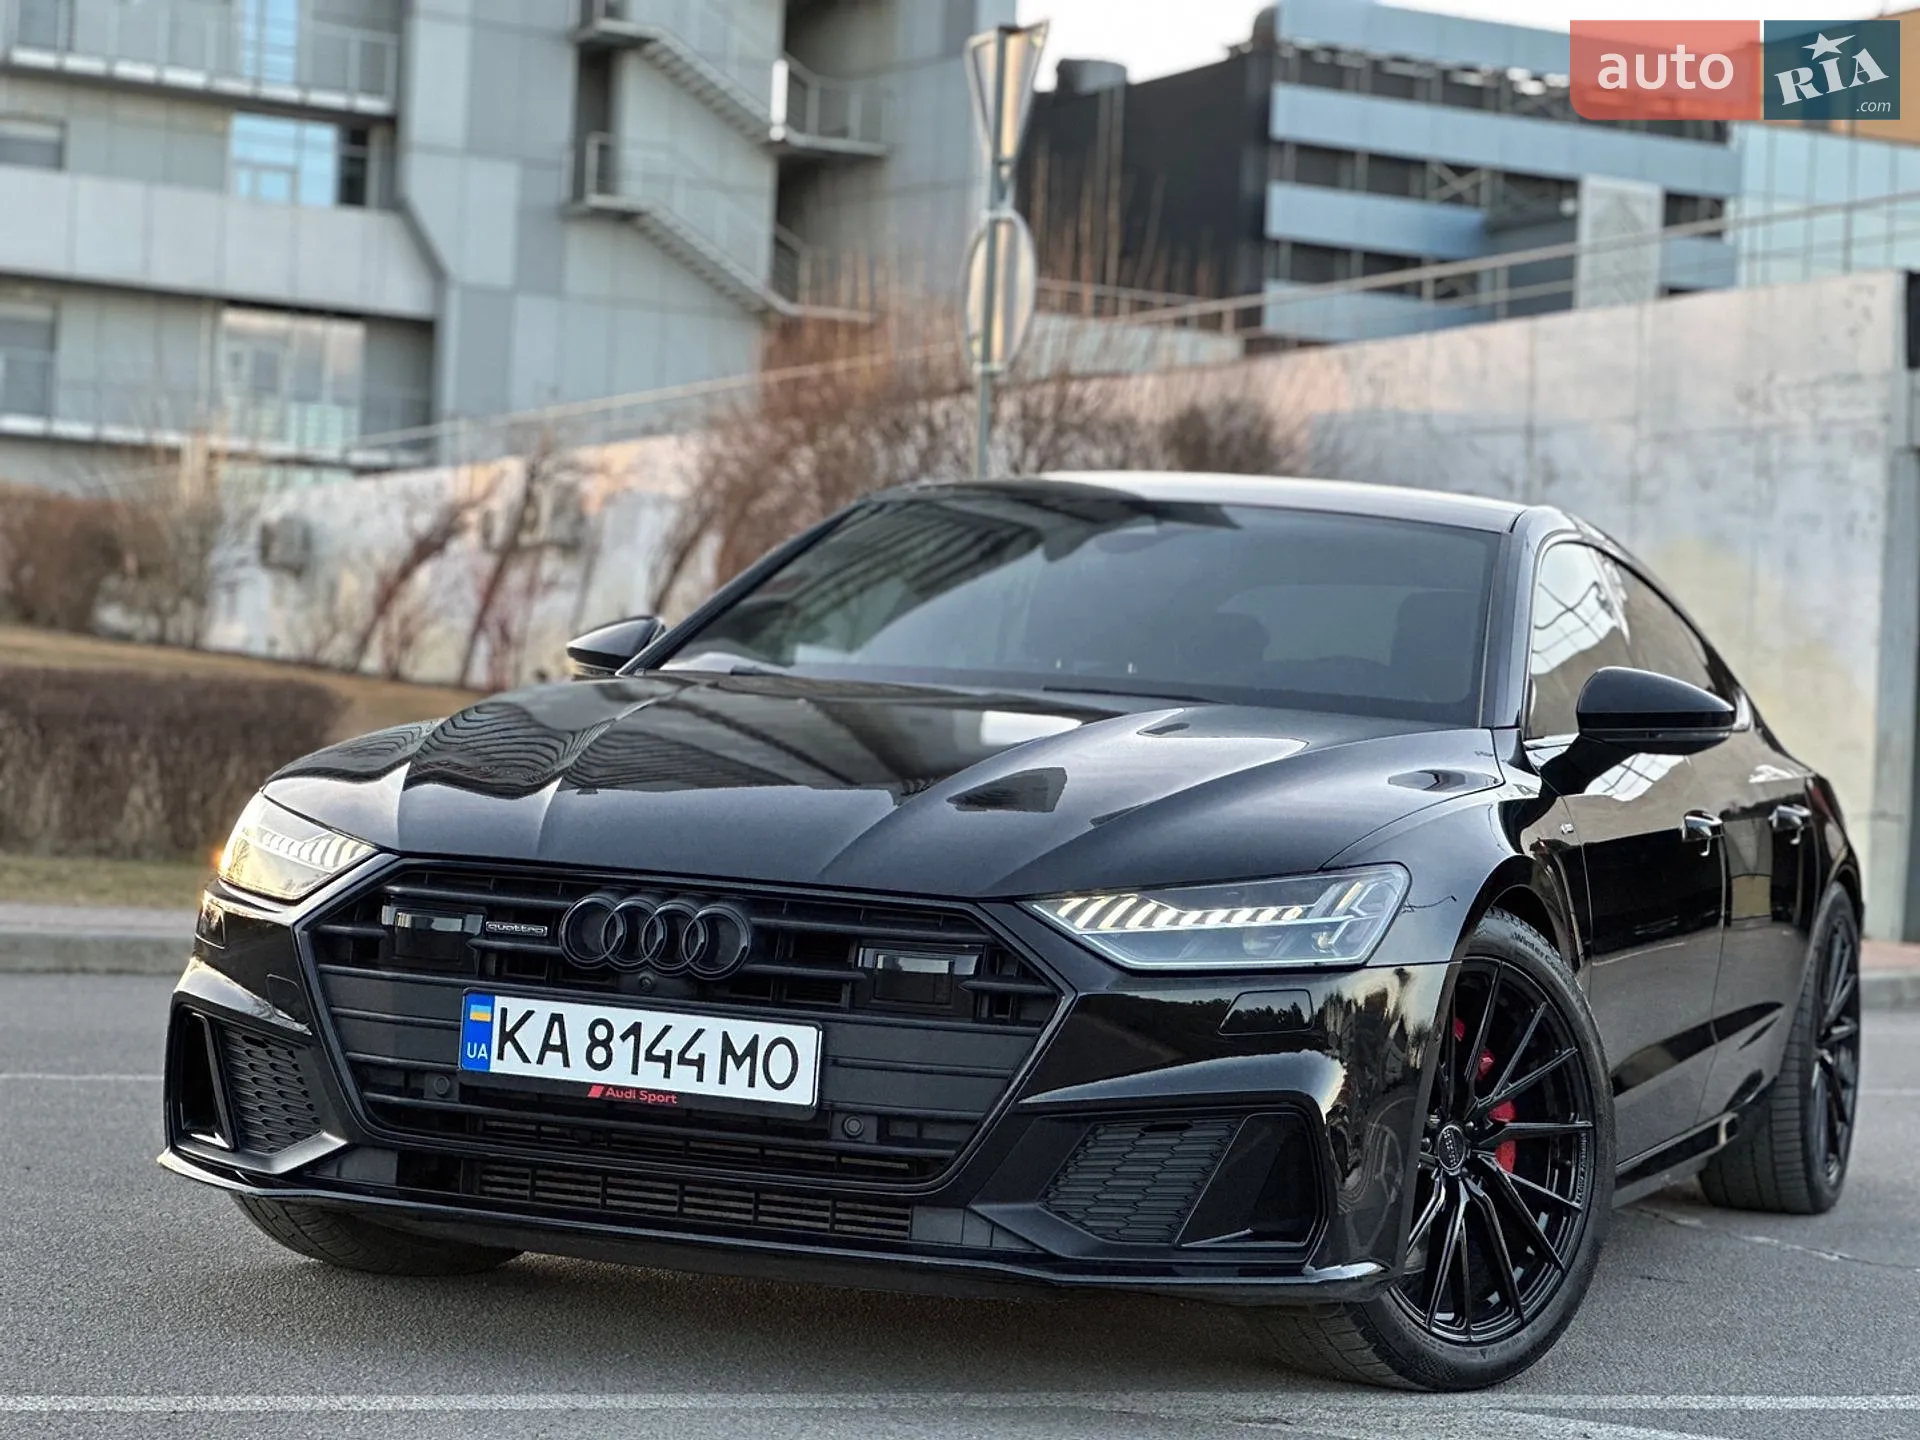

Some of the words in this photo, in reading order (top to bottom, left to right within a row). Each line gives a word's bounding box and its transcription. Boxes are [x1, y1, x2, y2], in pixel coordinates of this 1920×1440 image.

[467, 1042, 488, 1060] UA
[605, 1087, 636, 1099] Audi
[639, 1090, 678, 1104] Sport
